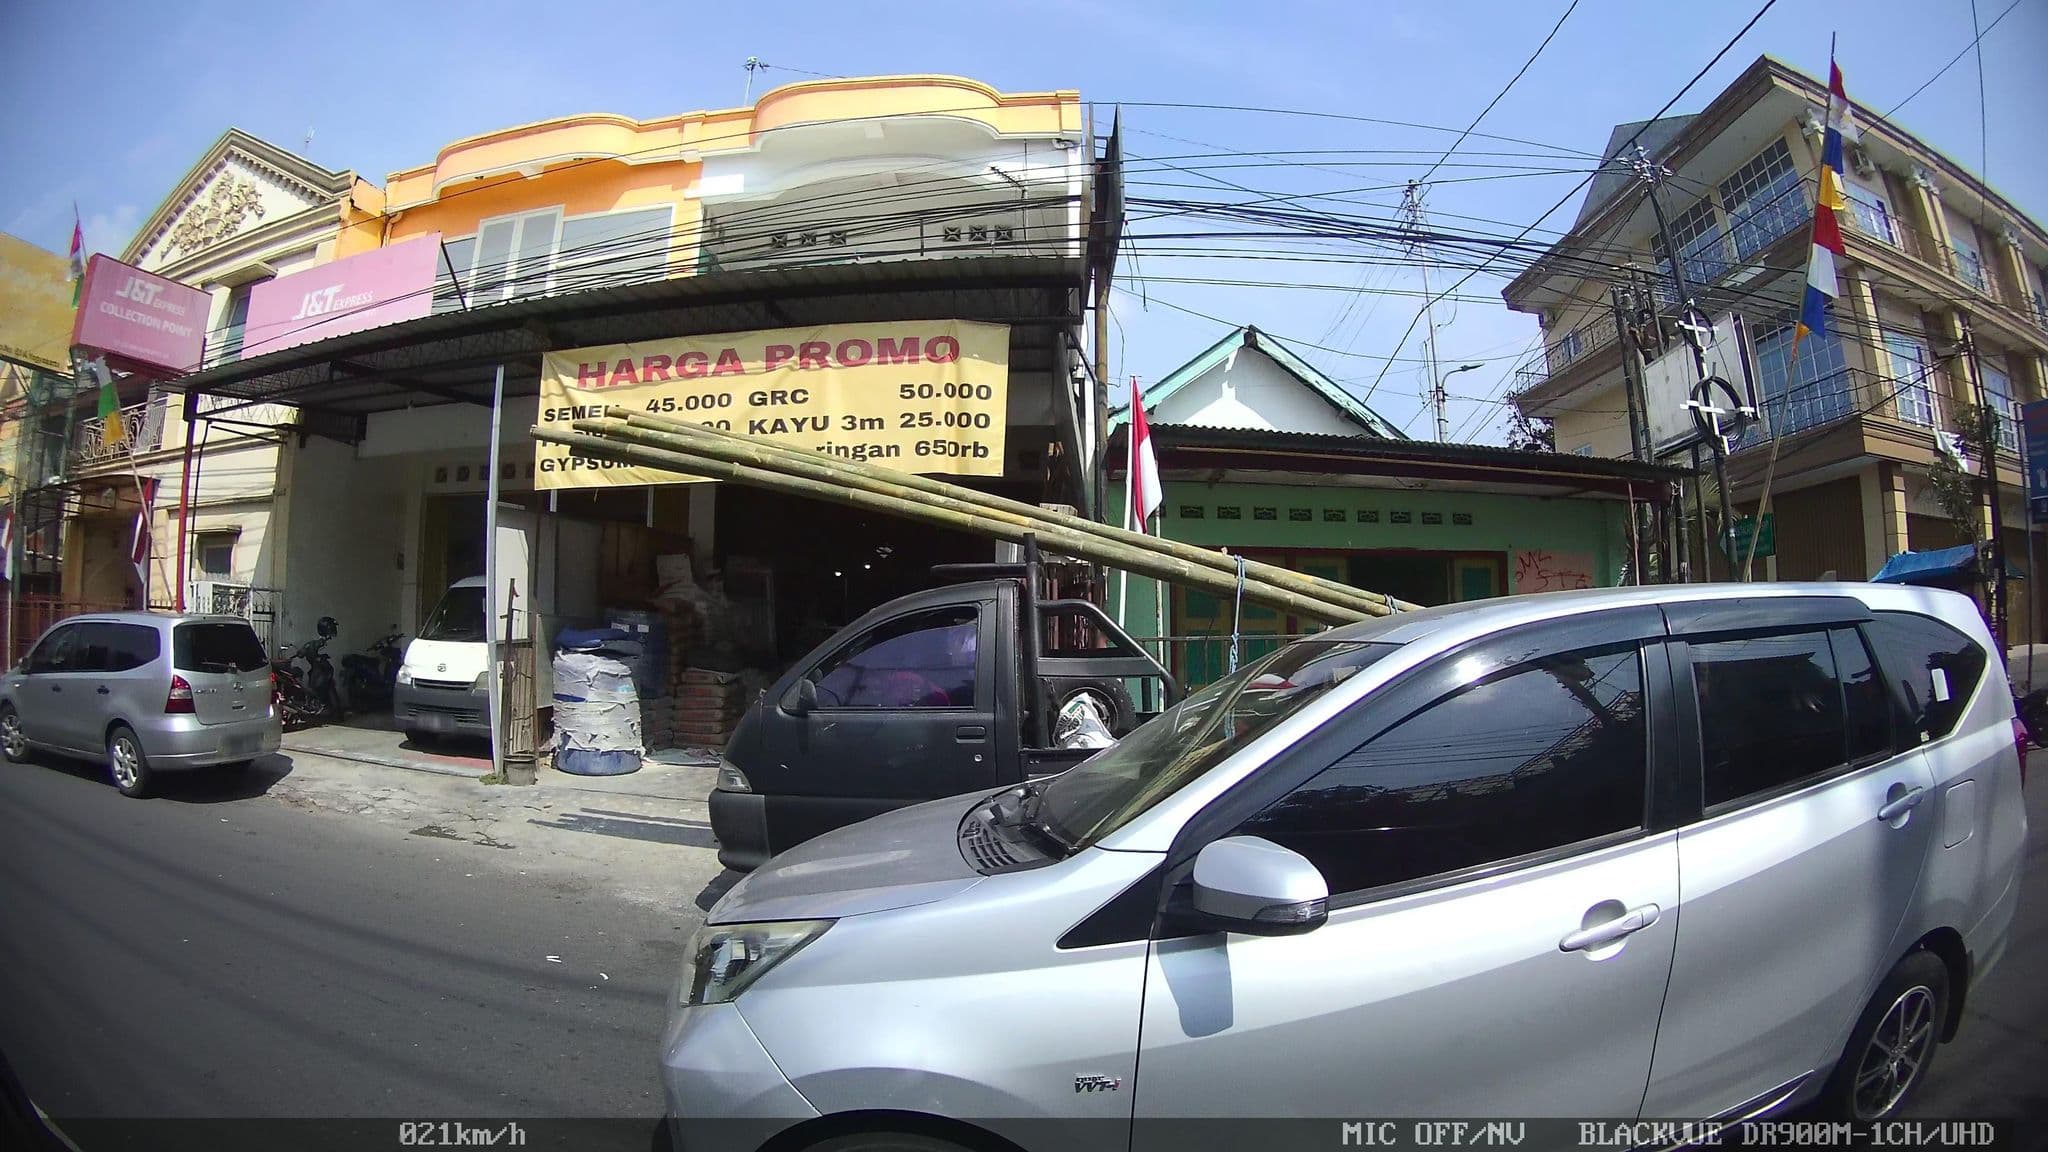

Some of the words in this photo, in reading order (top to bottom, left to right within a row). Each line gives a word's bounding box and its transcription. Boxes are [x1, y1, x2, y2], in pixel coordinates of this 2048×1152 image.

[115, 276, 165, 305] J&T
[292, 283, 345, 321] J&T
[333, 290, 374, 311] EXPRESS
[100, 301, 161, 331] COLLECTION
[162, 320, 193, 338] POINT
[576, 347, 748, 389] HARGA
[763, 335, 961, 372] PROMO
[645, 392, 732, 413] 45.000
[748, 389, 810, 407] GRC
[899, 382, 993, 401] 50.000
[748, 415, 831, 435] KAYU
[841, 415, 885, 431] 3m
[899, 411, 991, 429] 25.000
[914, 440, 990, 459] 650rb
